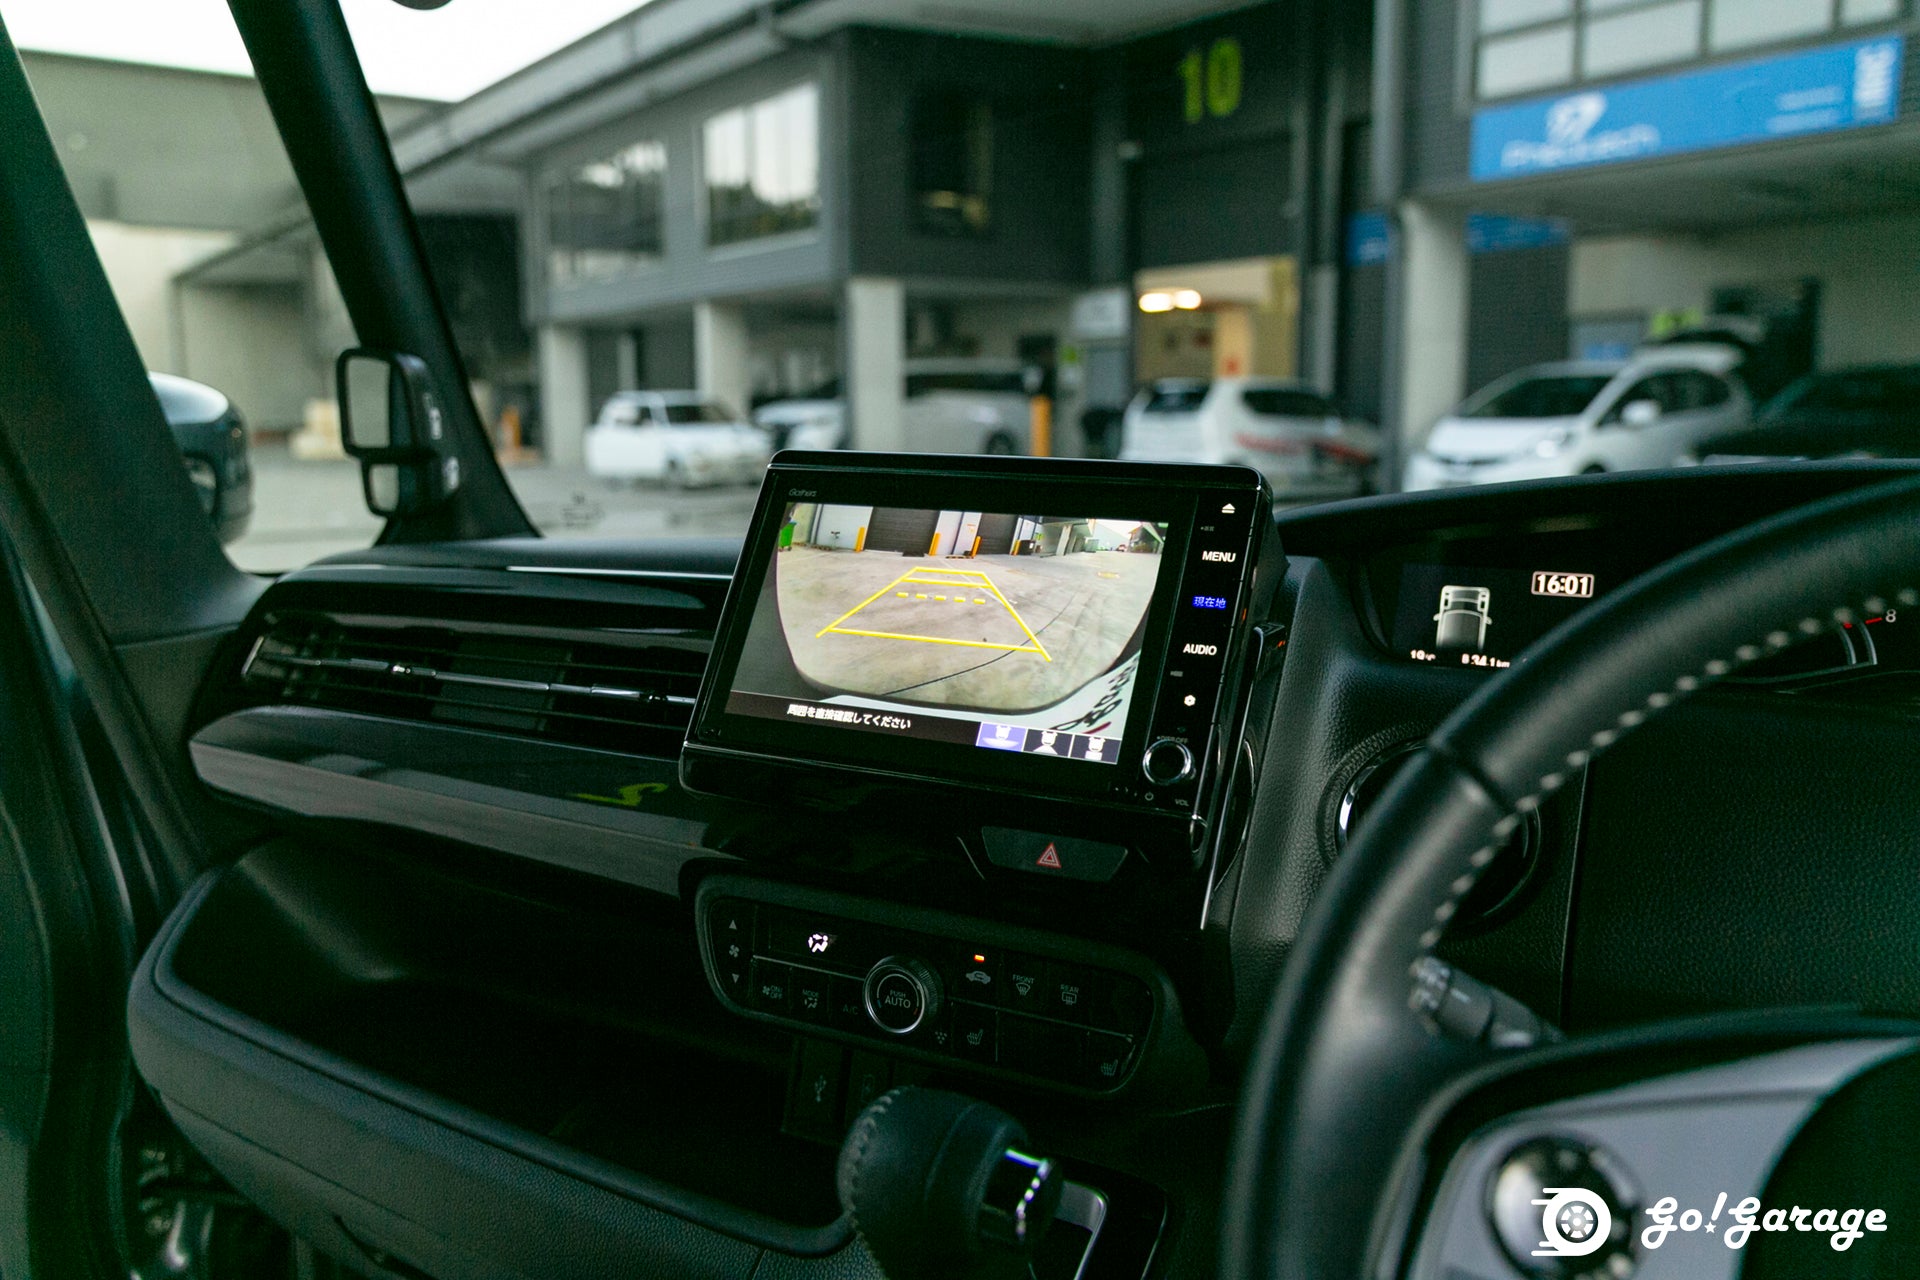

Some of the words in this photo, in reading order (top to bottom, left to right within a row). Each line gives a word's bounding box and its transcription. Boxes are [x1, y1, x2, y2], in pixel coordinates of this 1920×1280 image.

[1178, 38, 1241, 123] 10
[1201, 550, 1236, 563] MENU
[1537, 574, 1589, 595] 16:01
[1192, 595, 1227, 609] 現在地
[1885, 609, 1897, 623] 8
[1182, 643, 1217, 656] AUDIO
[1012, 974, 1034, 984] FRONT
[884, 995, 911, 1008] AUTO
